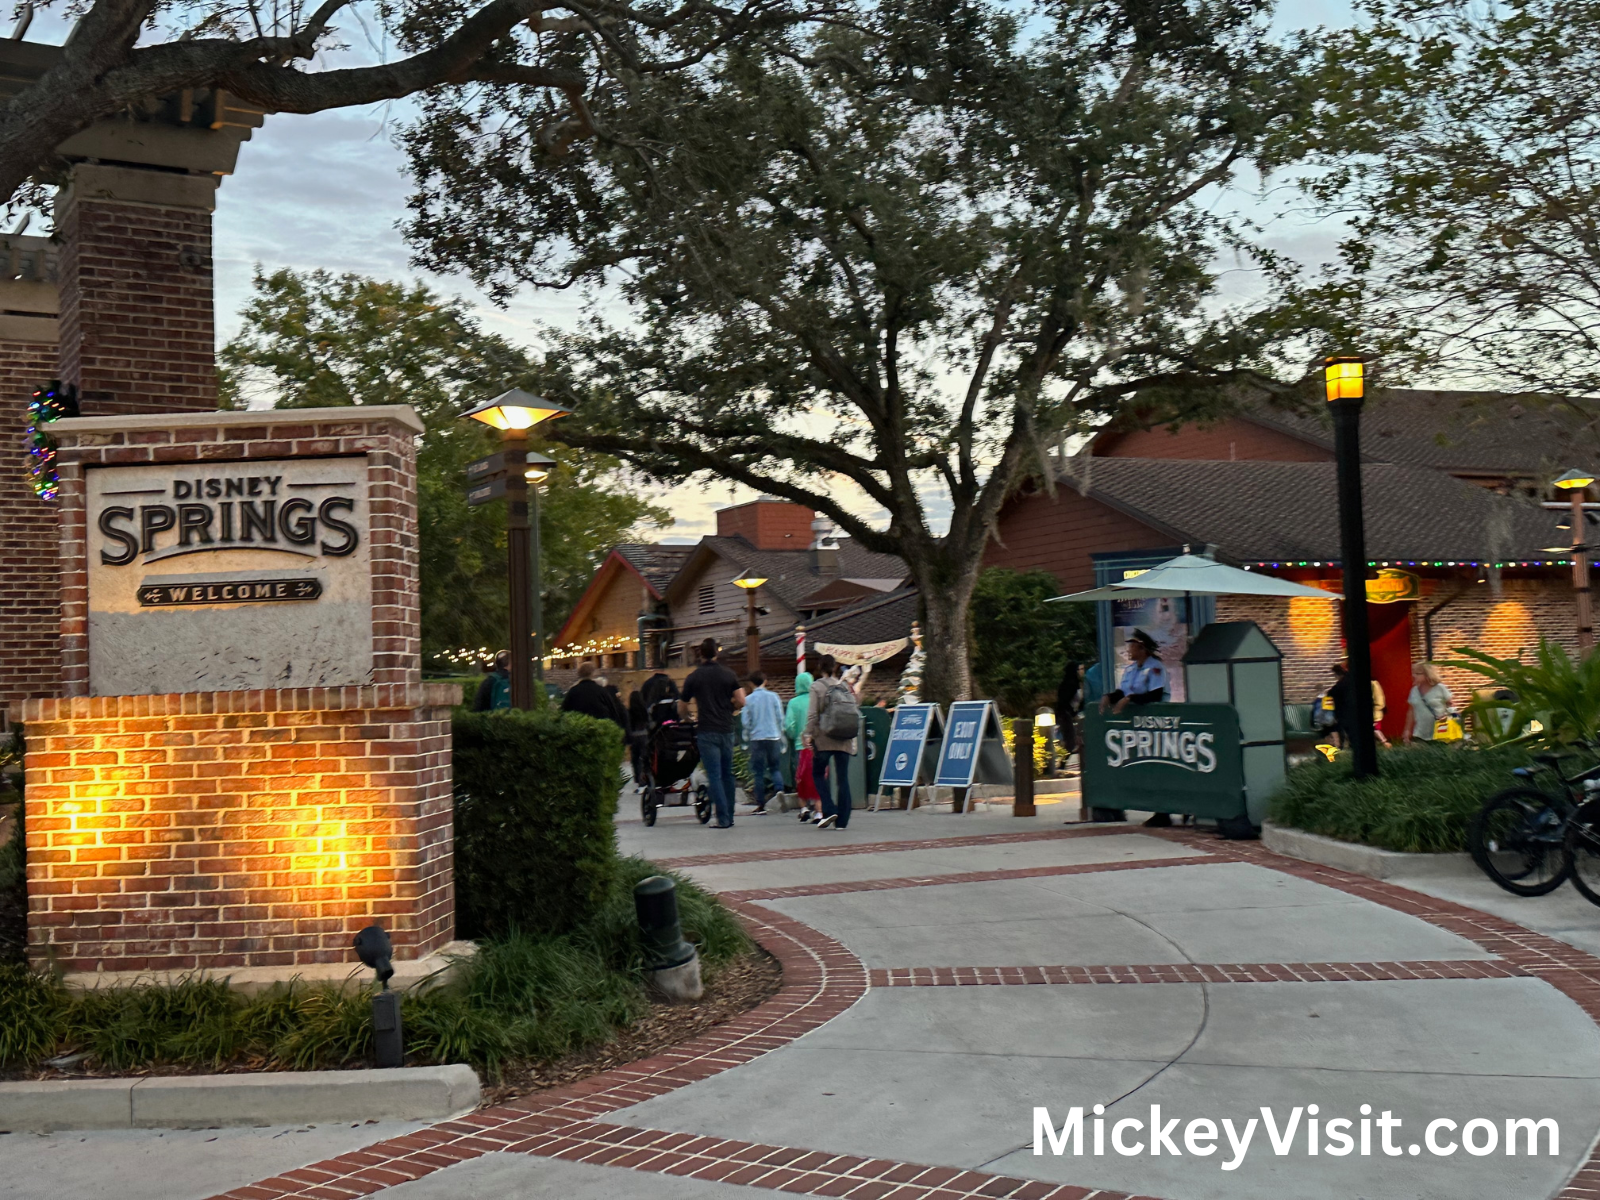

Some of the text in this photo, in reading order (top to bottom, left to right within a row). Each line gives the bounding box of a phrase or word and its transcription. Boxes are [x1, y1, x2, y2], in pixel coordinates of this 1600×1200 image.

[173, 475, 282, 499] DISNEY
[98, 496, 358, 566] SPRINGS
[168, 583, 288, 602] WELCOME
[953, 721, 977, 739] EXIT
[1133, 715, 1181, 729] DISNEY
[948, 742, 973, 760] ONLY
[1105, 729, 1217, 773] SPRINGS
